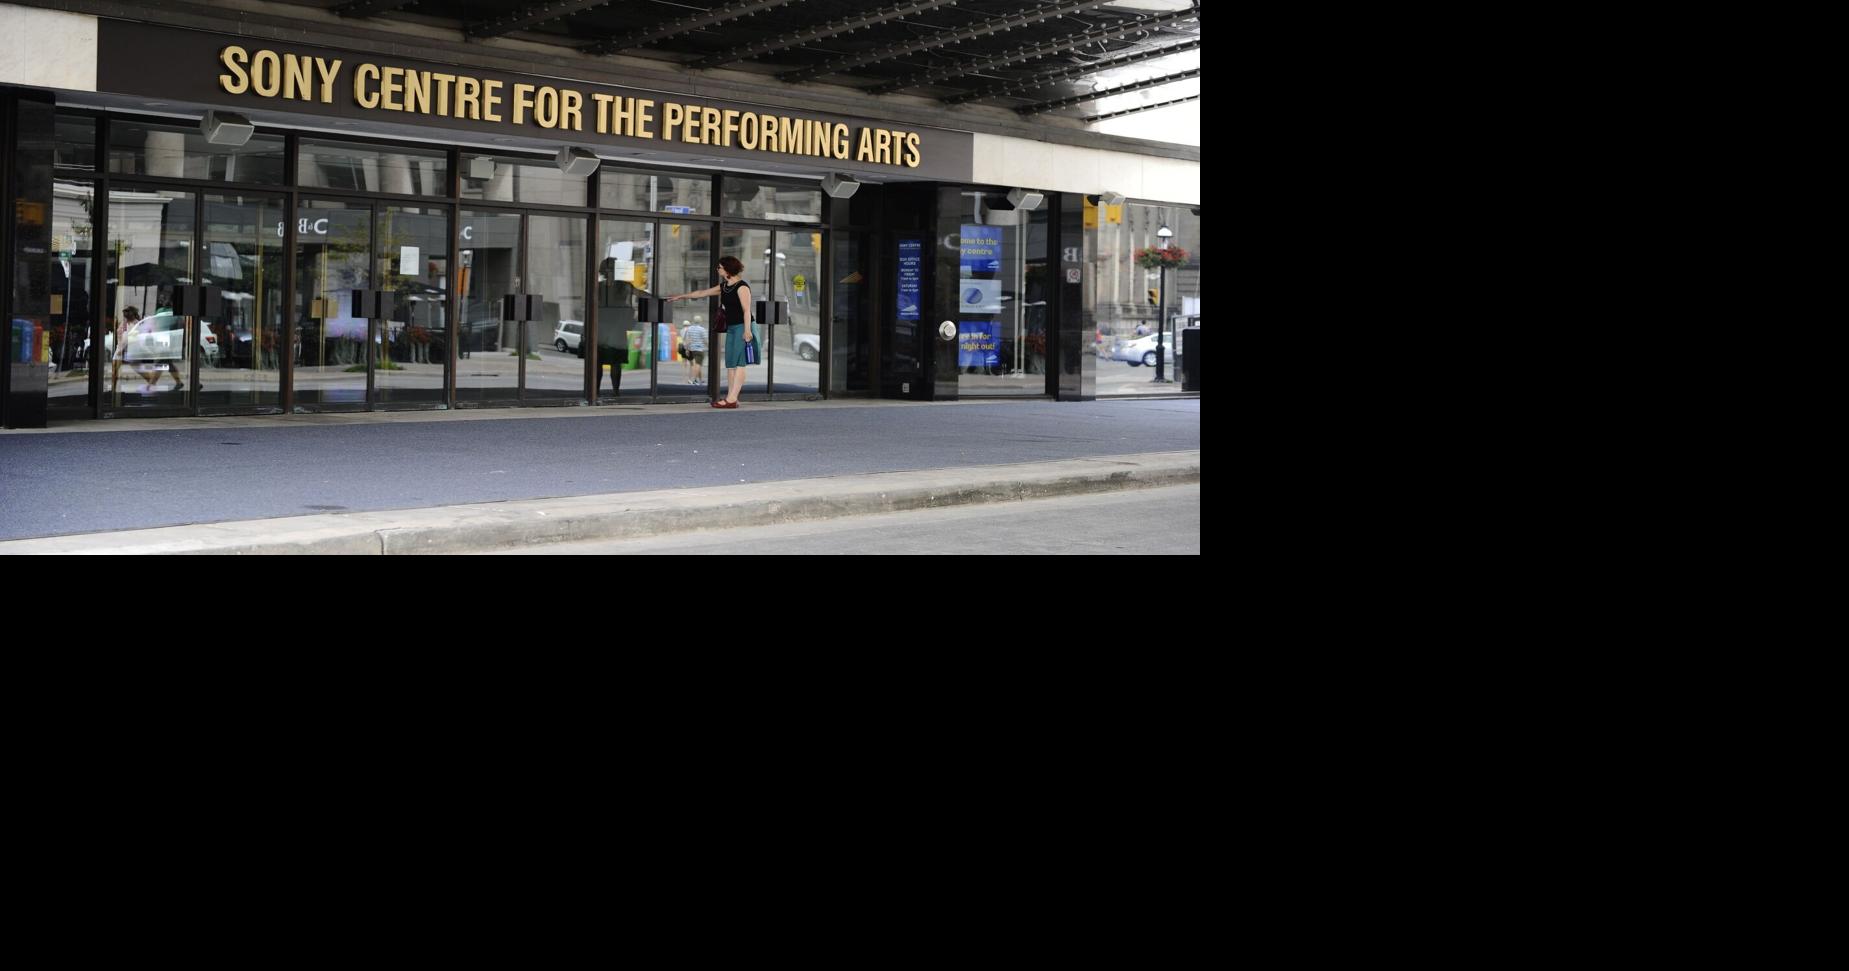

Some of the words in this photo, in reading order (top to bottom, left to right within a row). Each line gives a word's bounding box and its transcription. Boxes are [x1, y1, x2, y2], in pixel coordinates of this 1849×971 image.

[219, 45, 342, 103] SONY
[354, 63, 503, 122] CENTRE
[513, 83, 583, 131] FOR
[592, 93, 654, 139] THE
[662, 102, 850, 160] PERFORMING
[857, 127, 921, 168] ARTS
[961, 342, 980, 352] night
